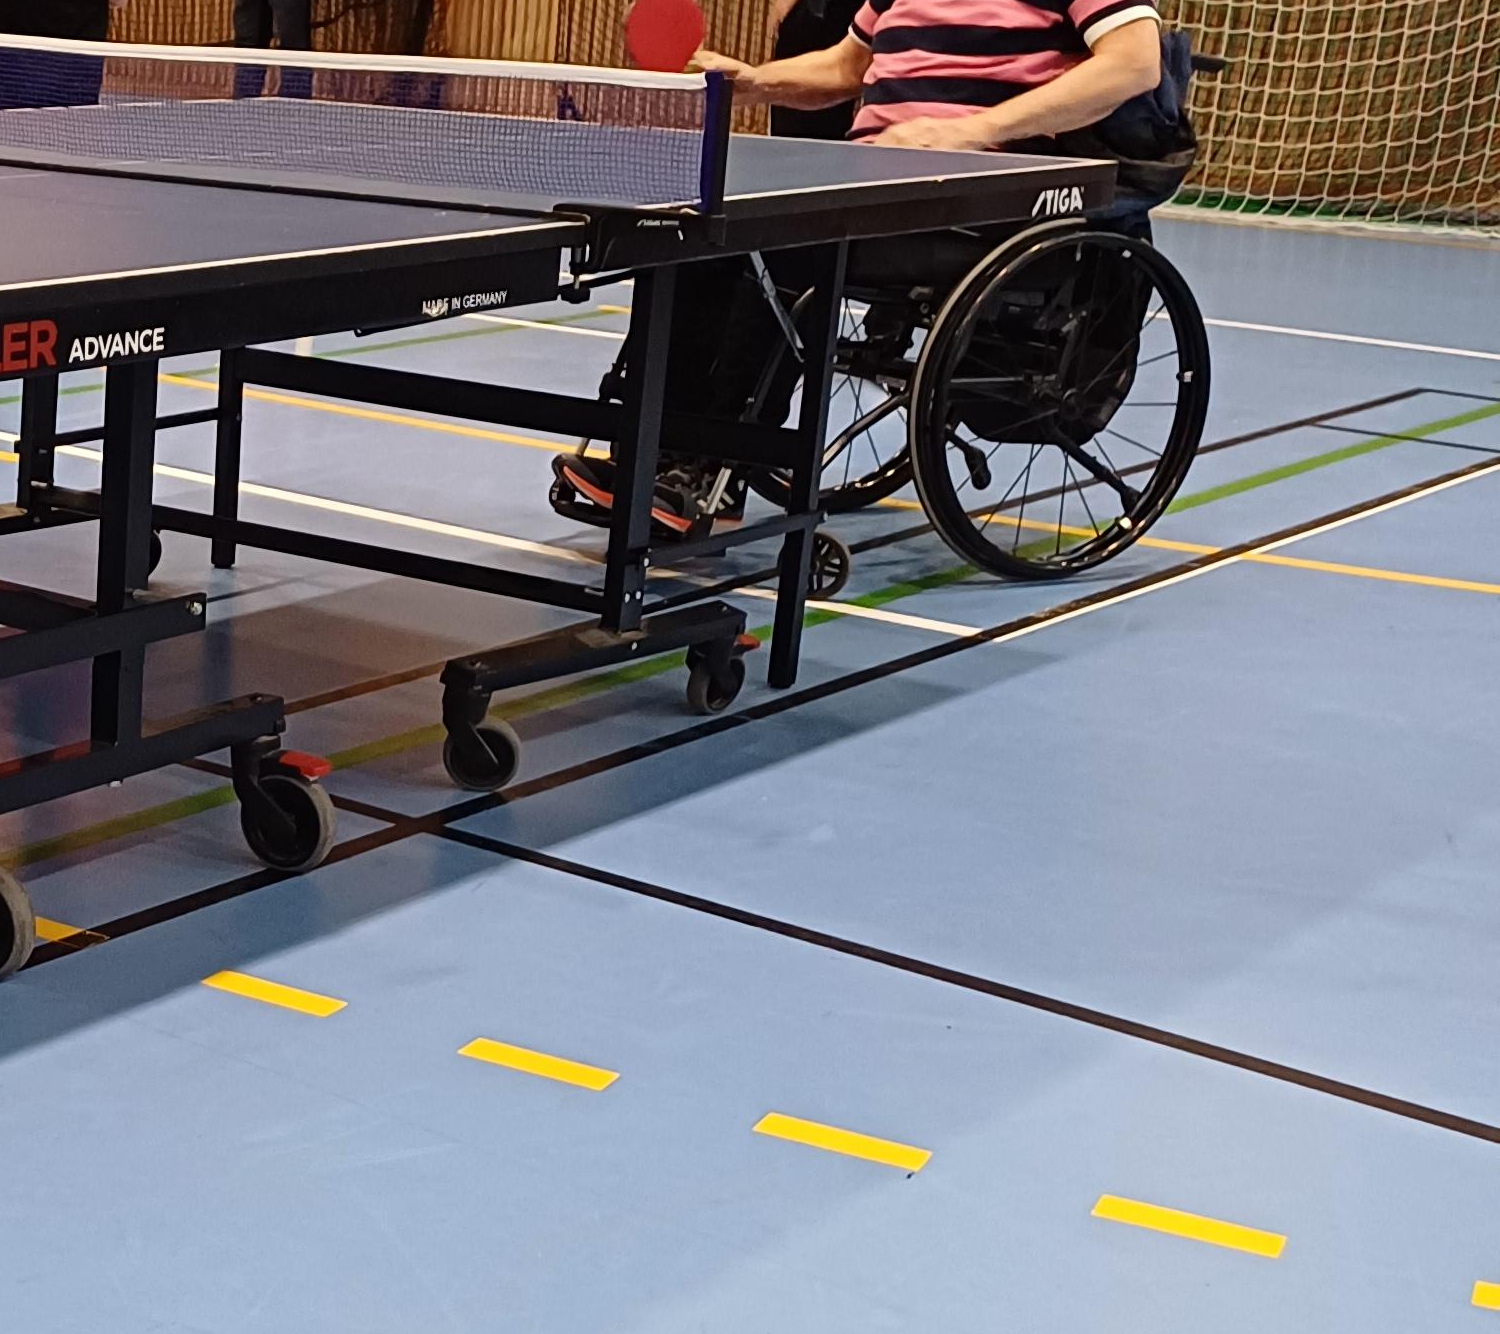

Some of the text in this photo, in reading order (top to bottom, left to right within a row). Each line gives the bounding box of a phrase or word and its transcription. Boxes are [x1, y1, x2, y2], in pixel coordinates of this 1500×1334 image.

[451, 296, 461, 310] IN
[462, 289, 508, 308] GERMANY
[68, 326, 166, 364] ADVANCE
